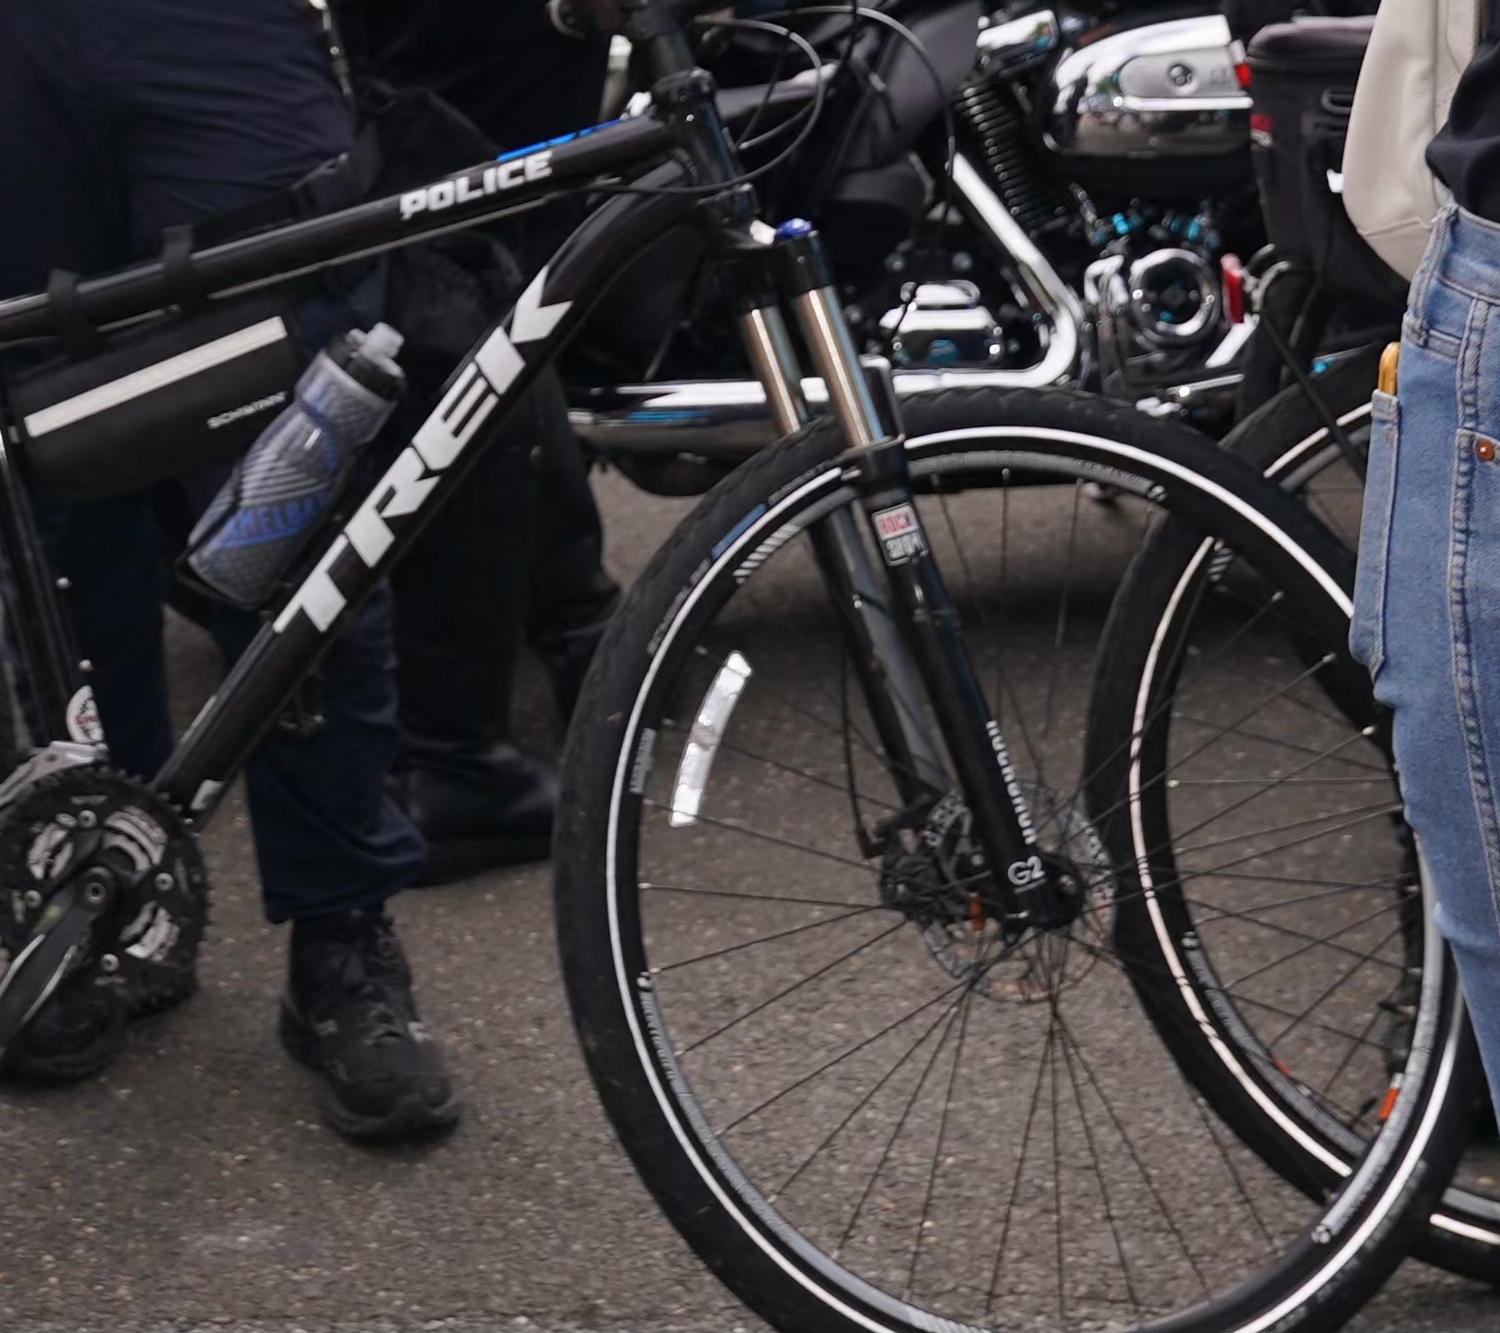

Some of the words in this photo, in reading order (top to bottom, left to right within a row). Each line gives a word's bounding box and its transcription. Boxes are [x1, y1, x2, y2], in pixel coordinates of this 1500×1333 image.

[400, 150, 553, 221] POLICE
[272, 264, 574, 633] TREK
[1007, 855, 1046, 885] G2
